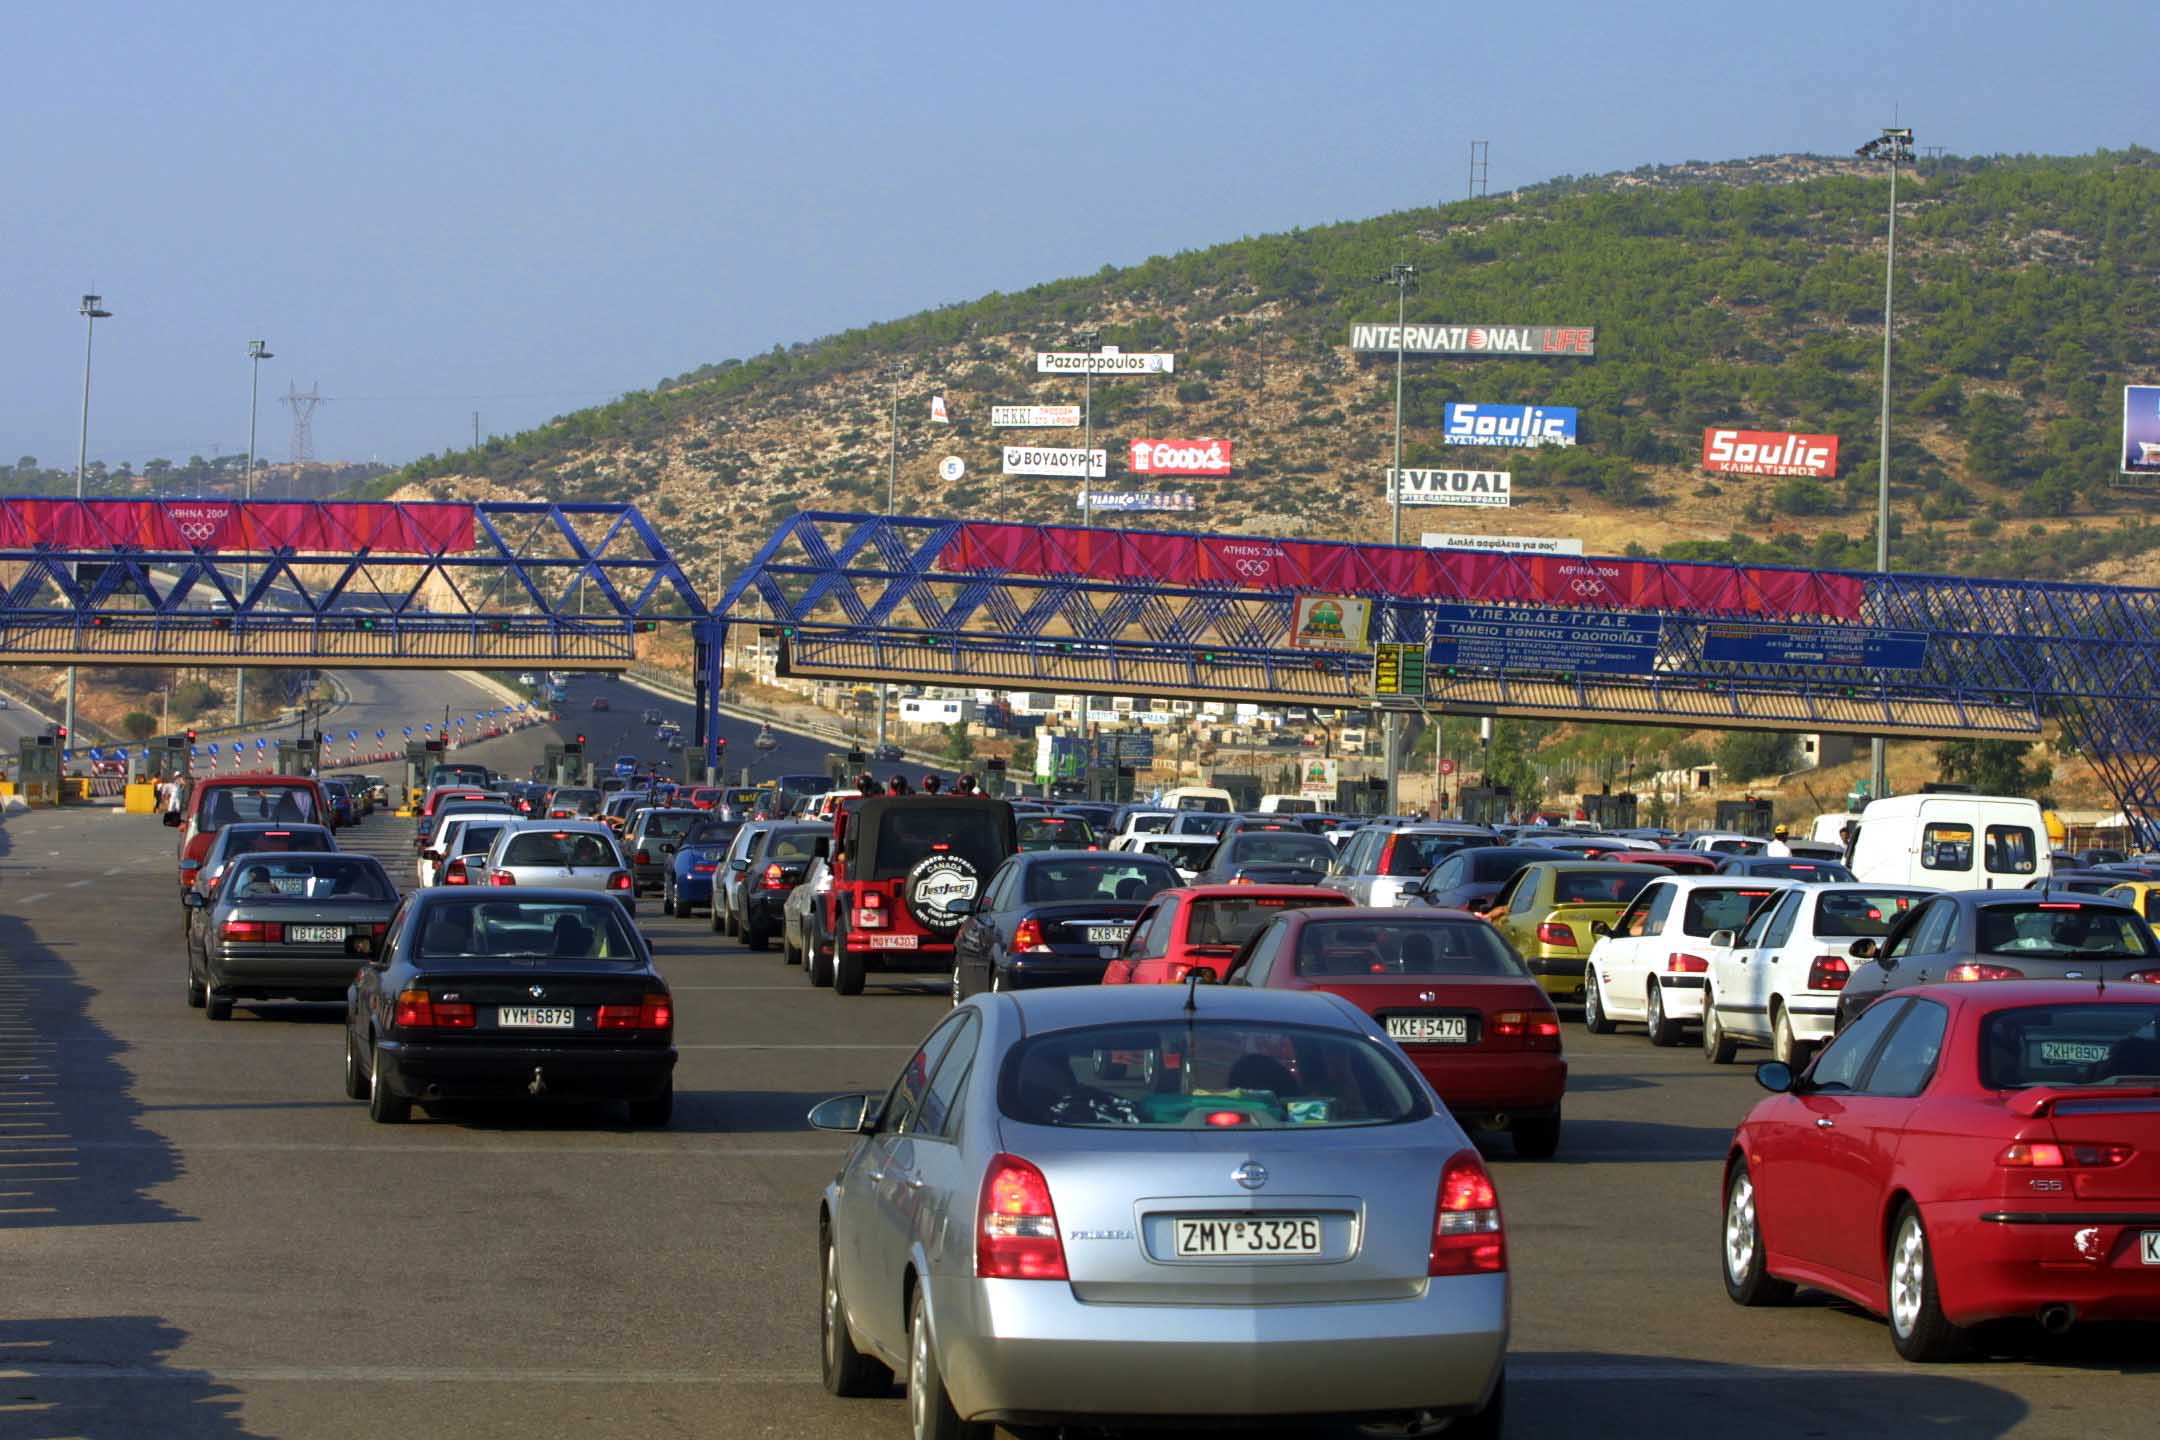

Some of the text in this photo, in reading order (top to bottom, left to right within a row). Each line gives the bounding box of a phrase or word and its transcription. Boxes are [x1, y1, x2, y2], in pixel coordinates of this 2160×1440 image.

[1352, 325, 1592, 352] INTERNATIONAL LIFE
[1046, 354, 1145, 372] Pazaropoulos
[1024, 451, 1103, 468] ΒΟΥΔΟΥΡΗΣ
[1720, 462, 1817, 477] ΚΛΙΜΑΤΙΣΜΟΣ
[1389, 471, 1508, 493] EVROAL
[1223, 545, 1260, 556] ATHENS
[1450, 623, 1499, 636] ΤΑΜΕΙΟ
[1505, 626, 1564, 640] ΕΘΝΙΚΗΣ
[926, 862, 962, 873] CANADA
[1070, 1230, 1136, 1241] PRIMERA
